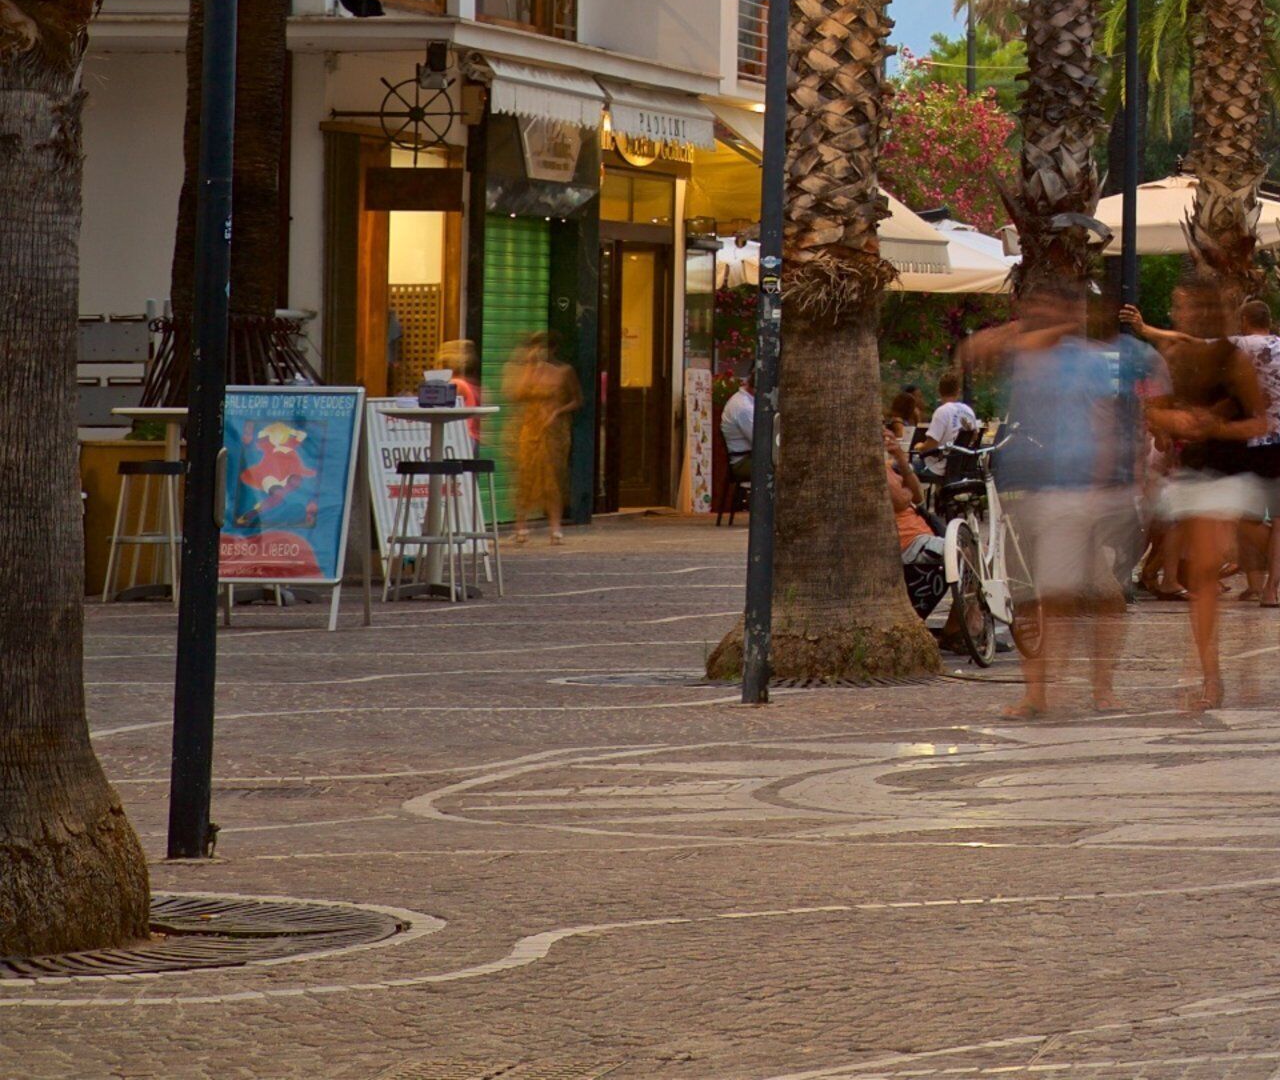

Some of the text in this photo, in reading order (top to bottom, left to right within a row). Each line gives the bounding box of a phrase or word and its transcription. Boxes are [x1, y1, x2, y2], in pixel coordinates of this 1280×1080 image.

[639, 112, 686, 138] PAOLINI
[382, 445, 455, 469] BAKKAO
[221, 543, 300, 557] RESSO LIBERO
